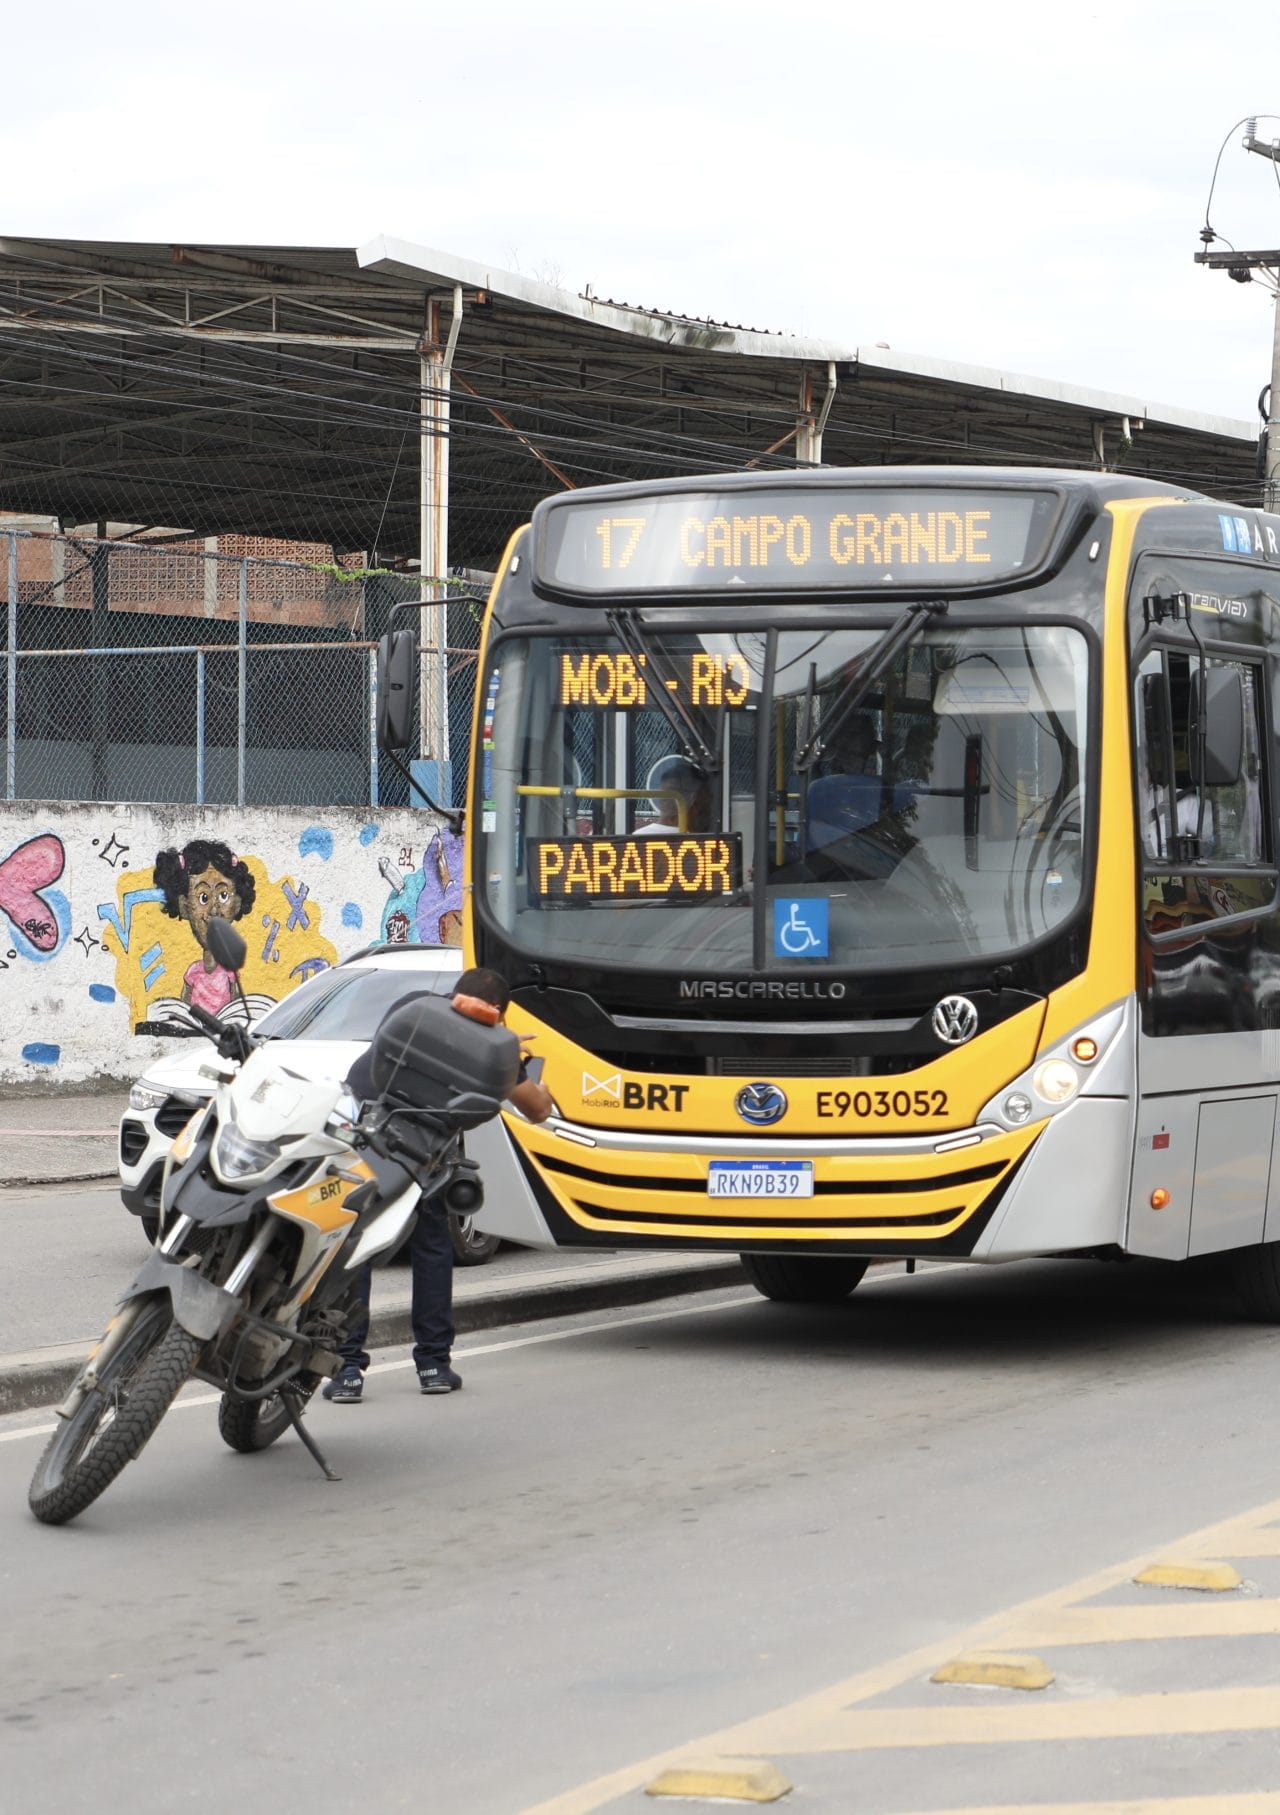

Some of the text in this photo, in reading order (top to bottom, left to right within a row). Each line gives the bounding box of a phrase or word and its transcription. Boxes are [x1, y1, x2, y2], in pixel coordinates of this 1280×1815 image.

[597, 511, 991, 569] 17 CAMPO GRANDE
[1254, 524, 1279, 554] AR
[691, 654, 750, 705] RIO
[539, 840, 731, 894] PARADOR
[680, 979, 846, 999] MASCARELLO
[623, 1081, 690, 1112] BRT
[816, 1089, 950, 1118] E903052
[320, 1179, 342, 1201] BRT
[717, 1173, 800, 1194] RKN9B39
